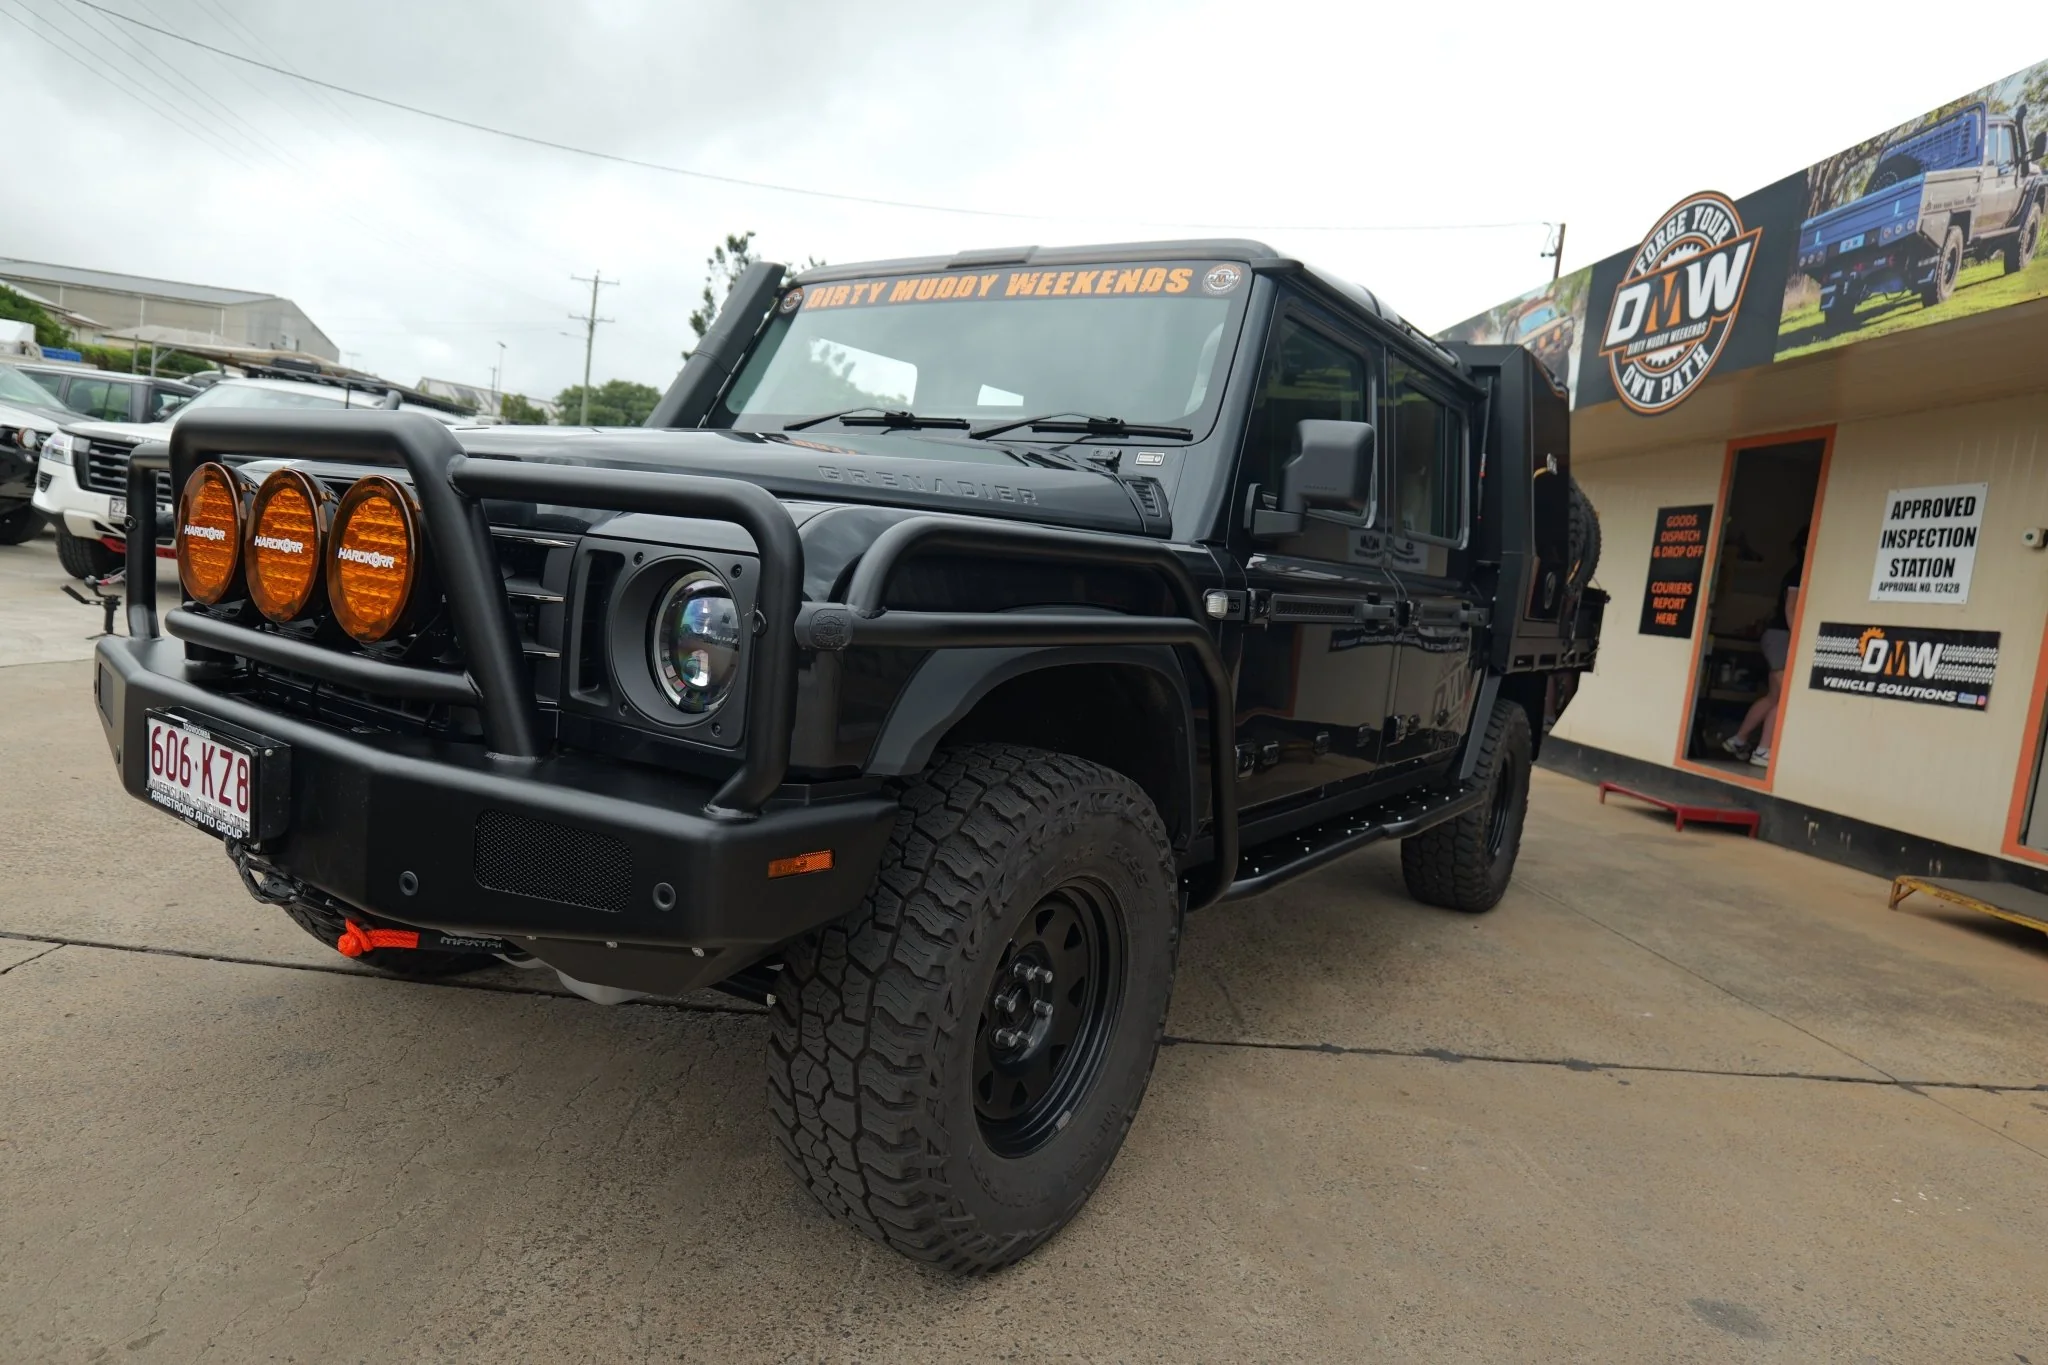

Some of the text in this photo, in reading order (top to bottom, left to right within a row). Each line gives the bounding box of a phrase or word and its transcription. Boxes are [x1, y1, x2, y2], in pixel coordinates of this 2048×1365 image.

[1635, 206, 1731, 276] FORGE YOUR
[805, 282, 887, 309] DIRTY
[888, 274, 999, 302] MUDDY
[1005, 267, 1193, 296] WEEKENDS
[1605, 241, 1751, 347] DMW
[1670, 321, 1707, 343] WEEKENDS
[1622, 344, 1710, 402] OWN PATH
[818, 465, 1039, 505] GRENADIER
[1891, 496, 1976, 520] APPROVED
[1666, 514, 1698, 527] GOODS
[1660, 530, 1701, 543] DISPATCH
[1881, 526, 1977, 549] INSPECTION
[1662, 545, 1685, 558] DROP
[1686, 545, 1704, 558] OFF
[1889, 558, 1955, 578] STATION
[1651, 582, 1693, 595] COURIERS
[1878, 582, 1917, 593] APPROVAL
[1919, 582, 1932, 593] NO.
[1652, 598, 1686, 610] REPORT
[1655, 613, 1678, 625] HERE
[1860, 638, 1944, 679] DMW
[1822, 676, 1875, 692] VEHICLE
[1876, 683, 1957, 702] SOLUTIONS
[151, 790, 194, 818] ARMSTRONG
[195, 811, 215, 828] AUTO
[216, 820, 243, 839] GROUP
